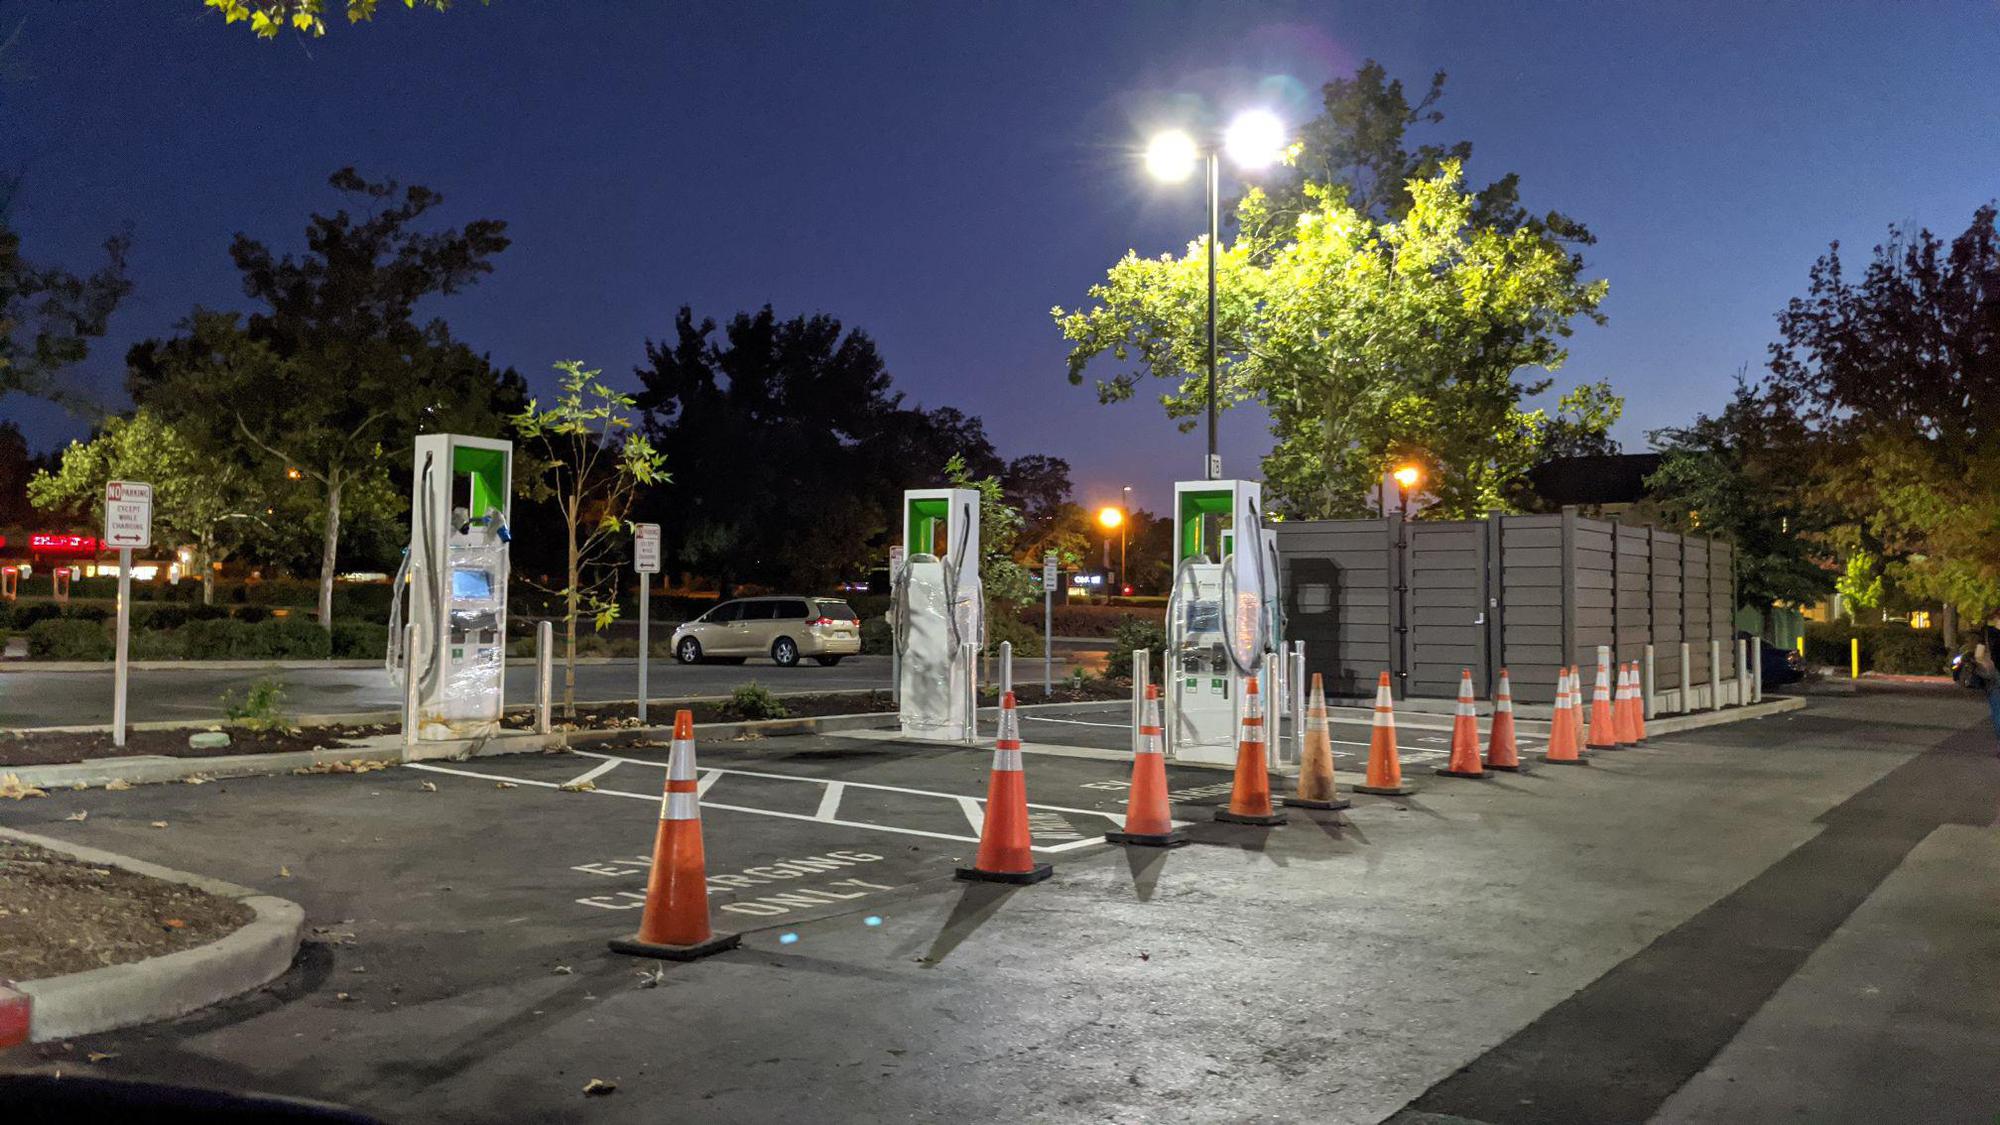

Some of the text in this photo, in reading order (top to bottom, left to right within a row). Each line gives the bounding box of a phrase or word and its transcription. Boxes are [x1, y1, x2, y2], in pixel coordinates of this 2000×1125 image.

[109, 485, 149, 498] NO PARKING
[575, 850, 884, 909] CRGING
[720, 879, 894, 915] ONLY
